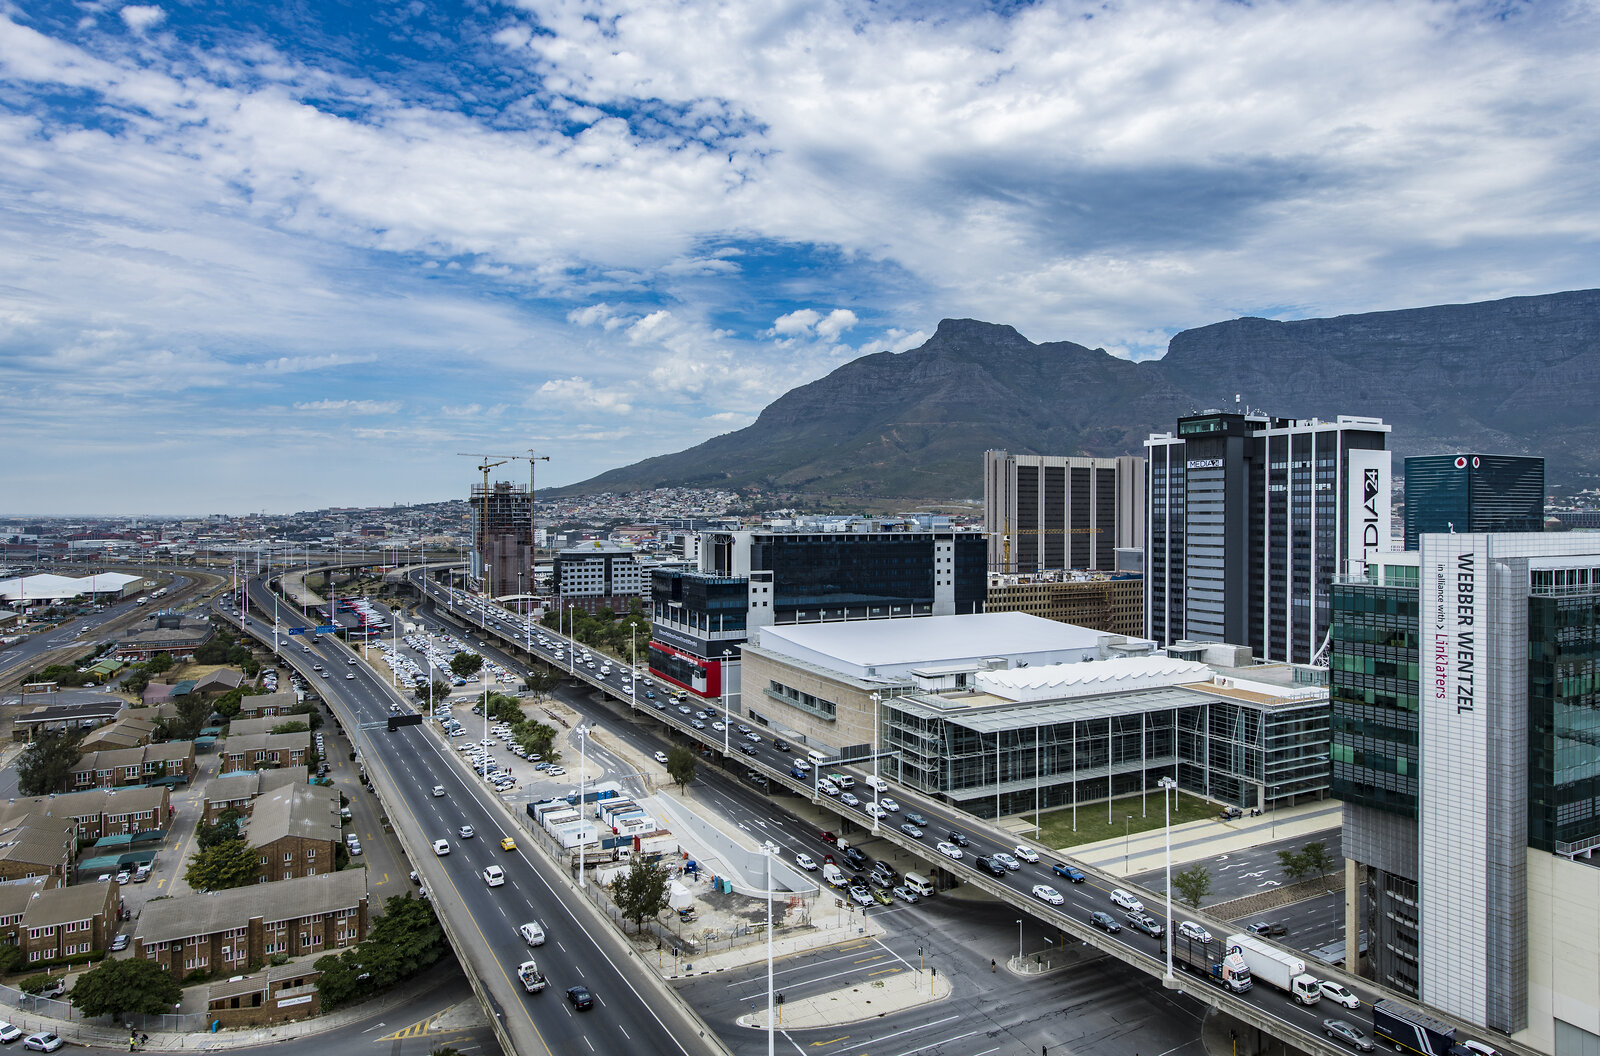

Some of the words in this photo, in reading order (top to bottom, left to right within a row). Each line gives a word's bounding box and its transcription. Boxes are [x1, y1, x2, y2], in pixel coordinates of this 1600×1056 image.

[1364, 468, 1378, 578] DIA24
[1437, 564, 1446, 572] in
[1437, 573, 1446, 603] alliance
[1457, 553, 1474, 625] WEBBER
[1437, 604, 1446, 623] with
[1435, 633, 1448, 699] Linklaters
[1457, 631, 1474, 715] WENTZEL
